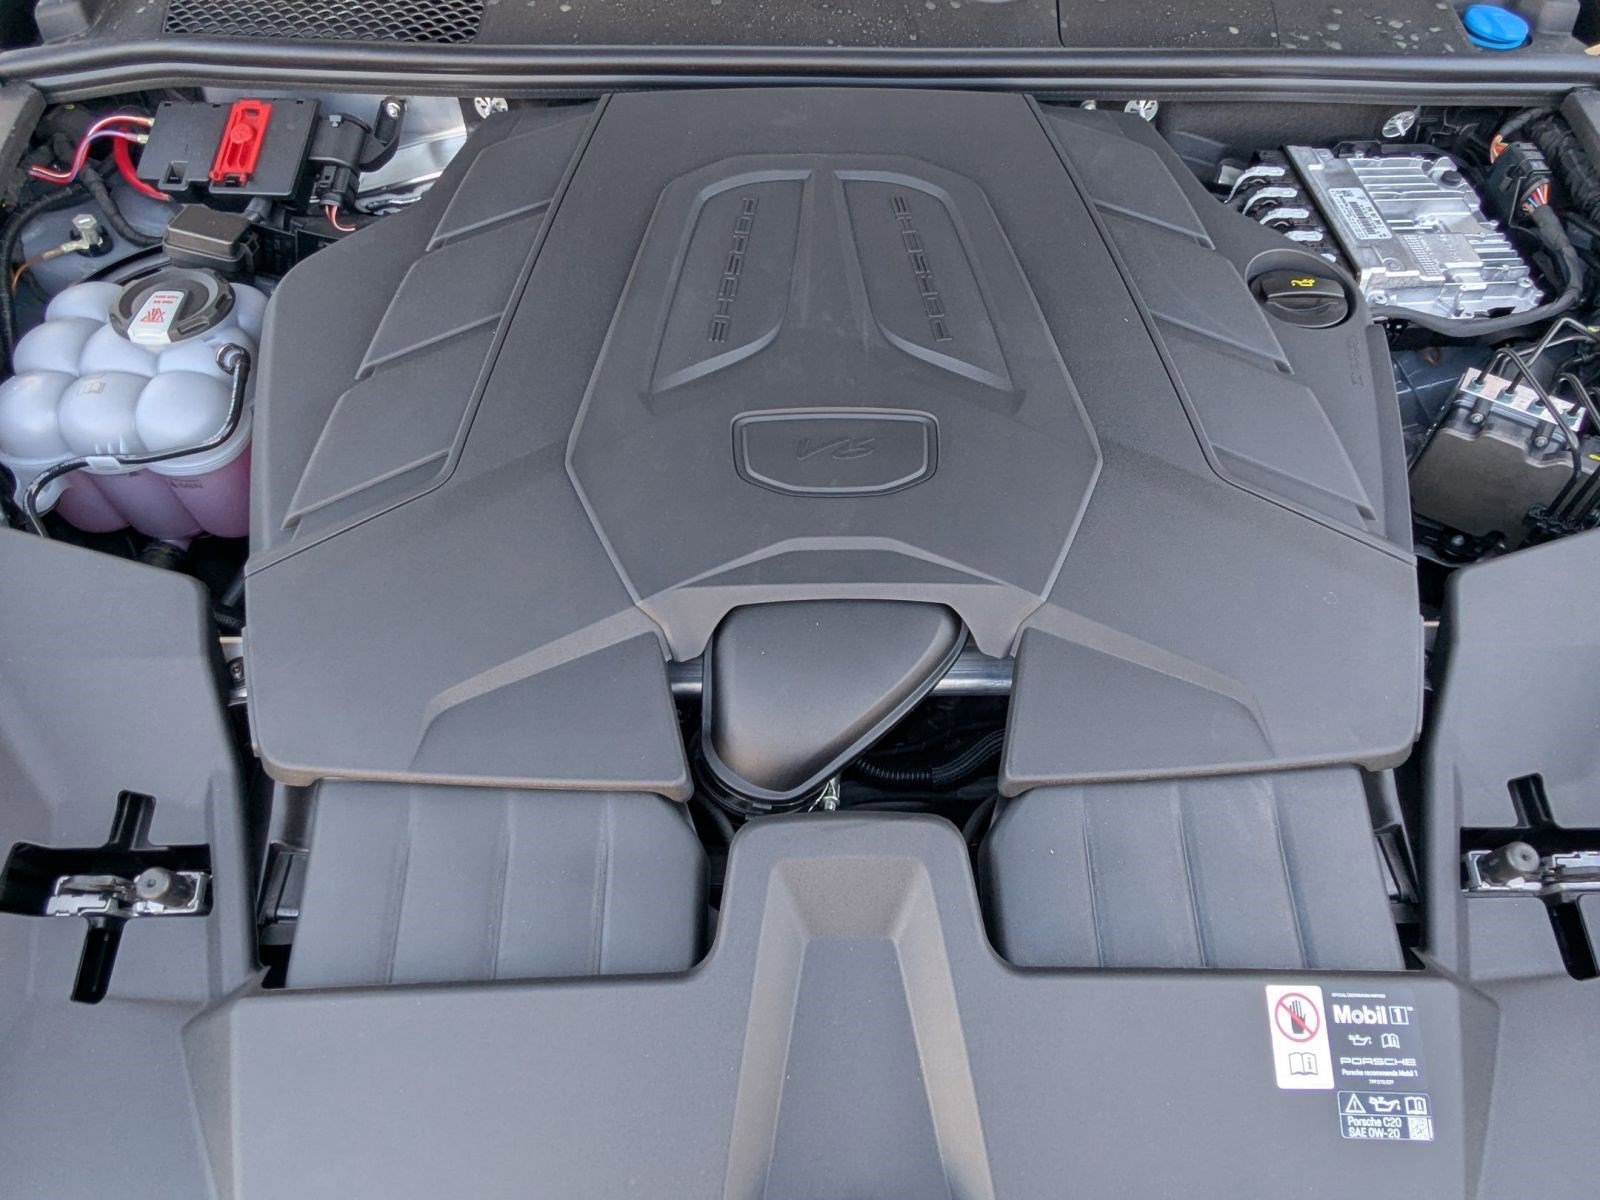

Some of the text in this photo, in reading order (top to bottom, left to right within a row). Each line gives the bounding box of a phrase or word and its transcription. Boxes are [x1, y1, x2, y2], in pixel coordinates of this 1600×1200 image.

[709, 196, 758, 342] PORSCHE
[889, 195, 953, 342] PORSCHE
[1333, 1005, 1388, 1025] Mobil
[1340, 1057, 1417, 1066] PORSCHE
[1348, 1117, 1402, 1128] Porsche C20
[1349, 1128, 1400, 1138] SAE 0W-20
